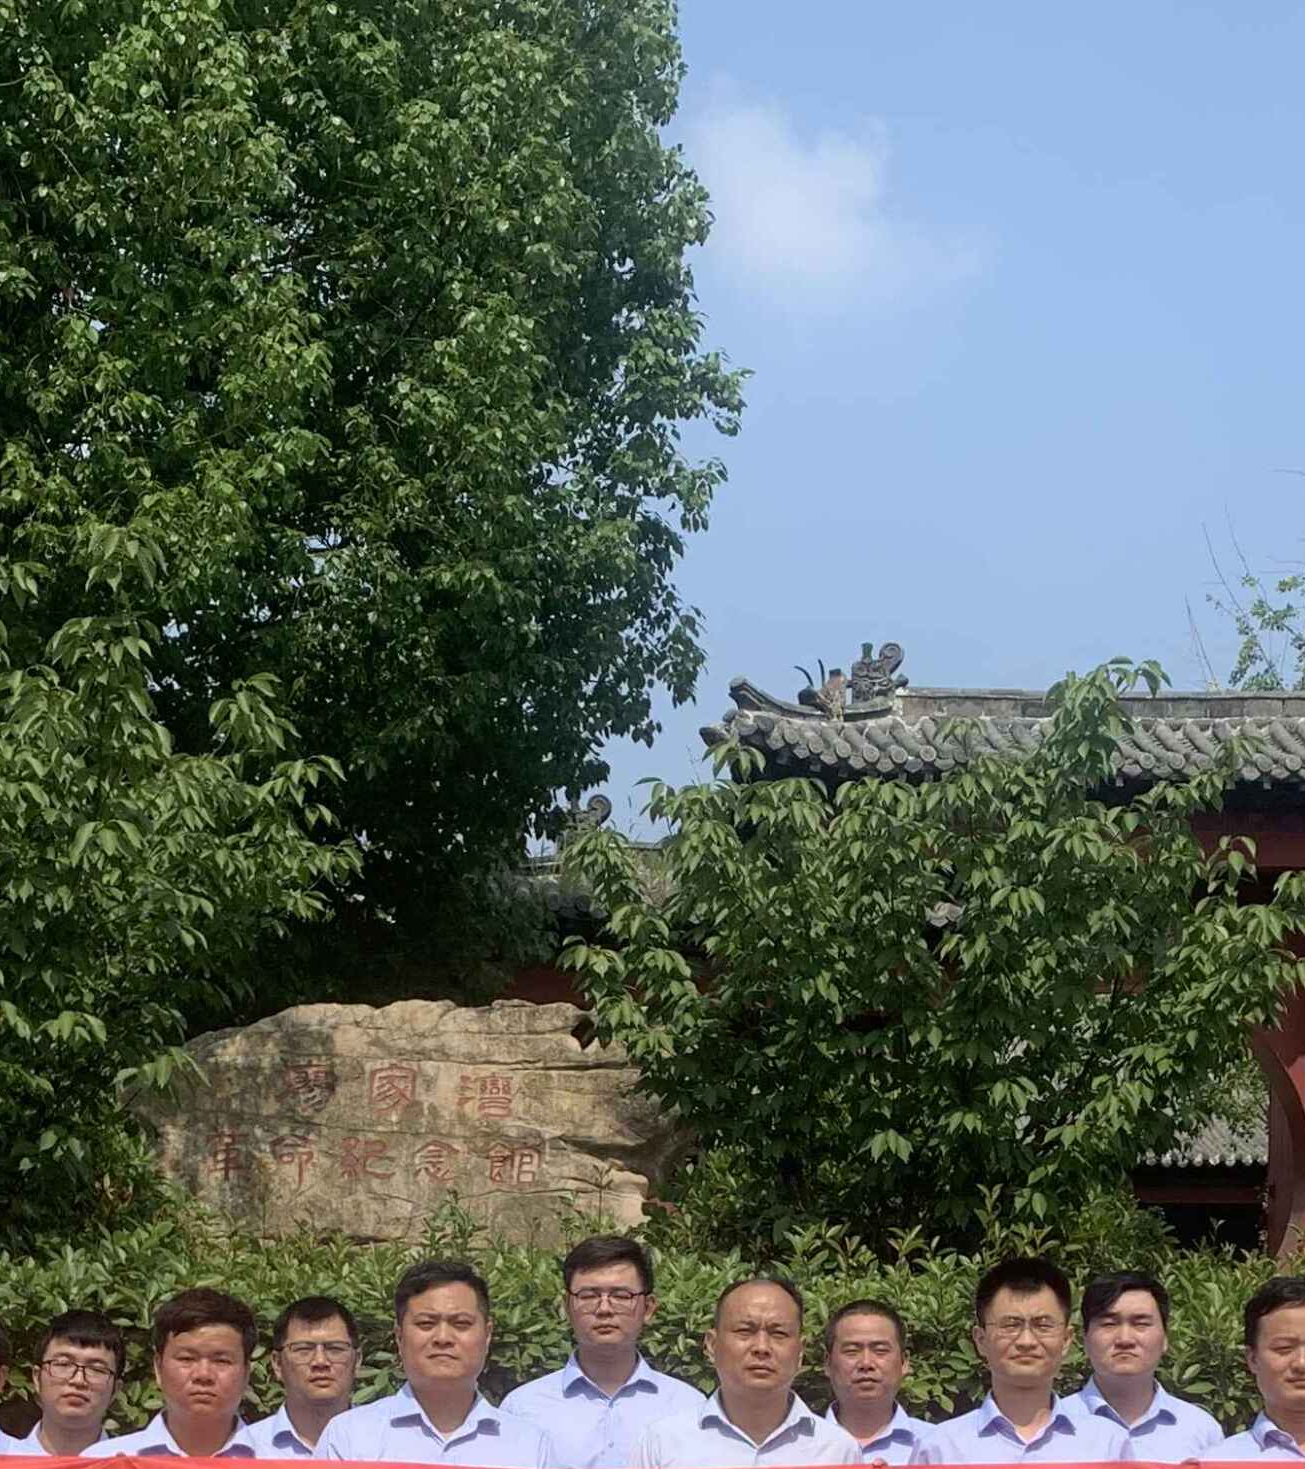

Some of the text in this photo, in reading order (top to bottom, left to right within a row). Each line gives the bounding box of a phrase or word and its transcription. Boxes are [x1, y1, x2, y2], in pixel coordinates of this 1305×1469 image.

[207, 1128, 542, 1188] 革命紀念館
